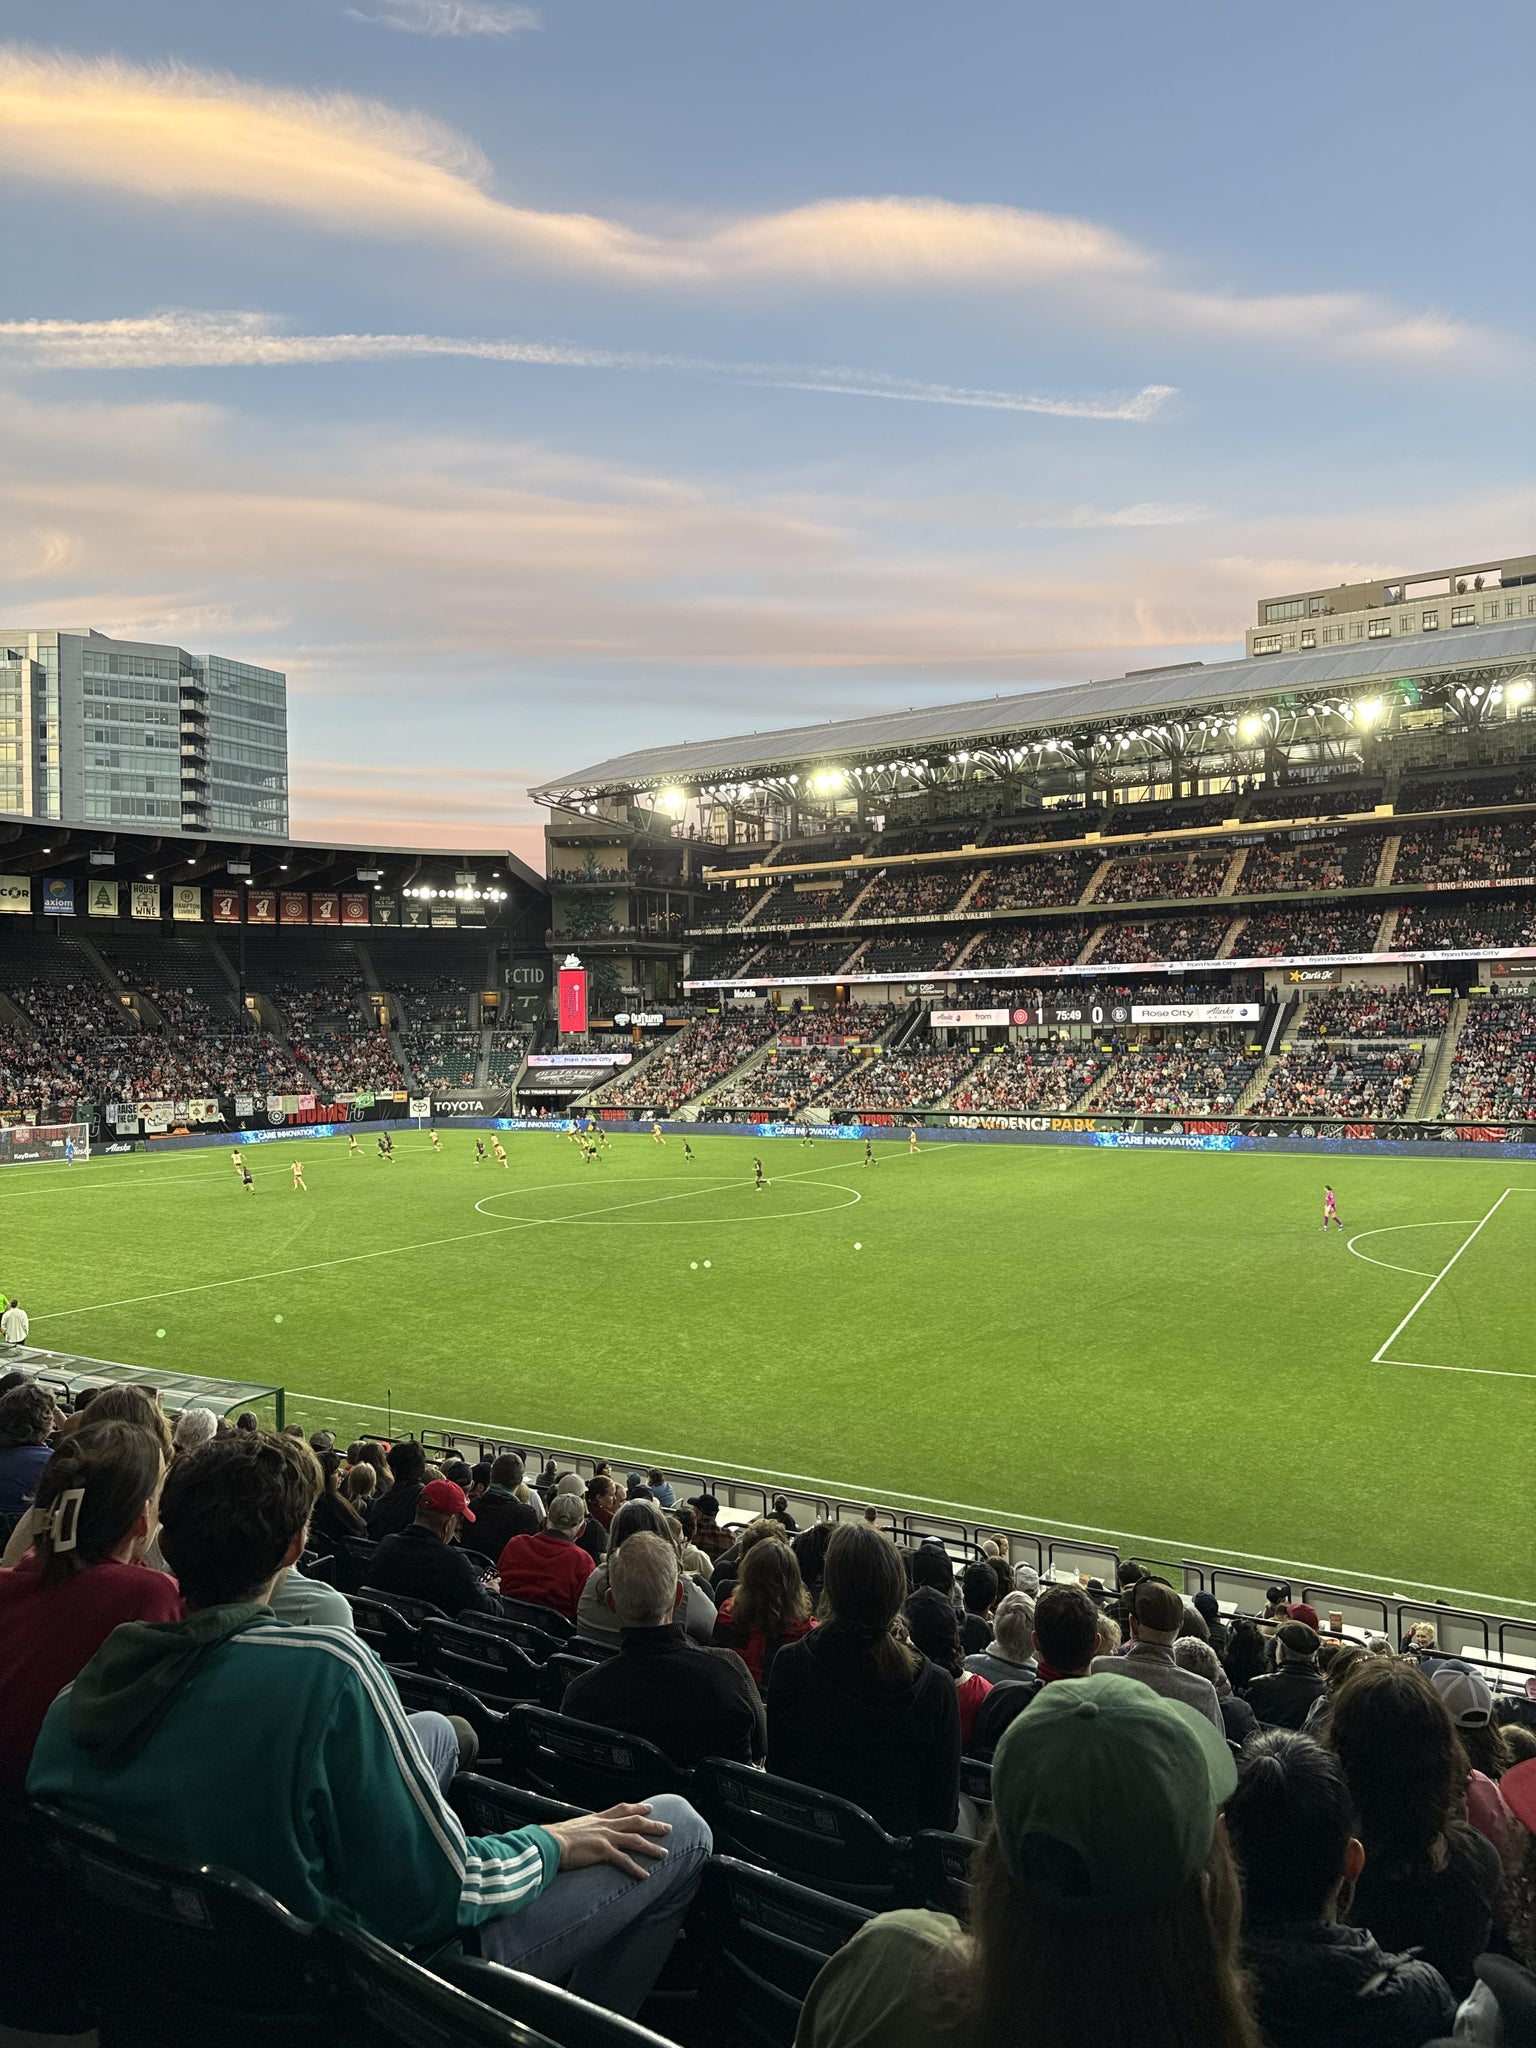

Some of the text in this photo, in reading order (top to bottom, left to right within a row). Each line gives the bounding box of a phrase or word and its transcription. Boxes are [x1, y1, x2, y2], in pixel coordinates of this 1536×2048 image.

[1437, 882, 1456, 890] RING
[1462, 880, 1491, 889] HONOR
[1495, 877, 1535, 887] CHRISTINE
[133, 884, 158, 894] HOUSE
[44, 898, 73, 906] axiom
[135, 907, 156, 916] WINE
[777, 923, 805, 931] CHARLES
[944, 913, 964, 921] DIEGO
[1300, 971, 1321, 980] Carl's
[734, 989, 756, 998] Modelo
[1035, 1008, 1043, 1024] 1
[1056, 1010, 1081, 1020] 75:49
[1092, 1007, 1103, 1024] 0
[1171, 1010, 1194, 1018] City
[1206, 1007, 1234, 1015] Alaska
[118, 1104, 137, 1114] RAISE
[434, 1101, 484, 1111] TOYOTA
[118, 1114, 137, 1123] THE CAP
[950, 1116, 1096, 1131] PROVIDENCE PARK
[775, 1127, 839, 1136] CARE INOVATION
[1183, 1121, 1227, 1134] THORNS
[277, 1128, 315, 1138] INNOVATION
[1117, 1136, 1203, 1146] CARE INNOVATION
[105, 1143, 131, 1153] Alaska
[14, 1152, 39, 1160] KeyBank
